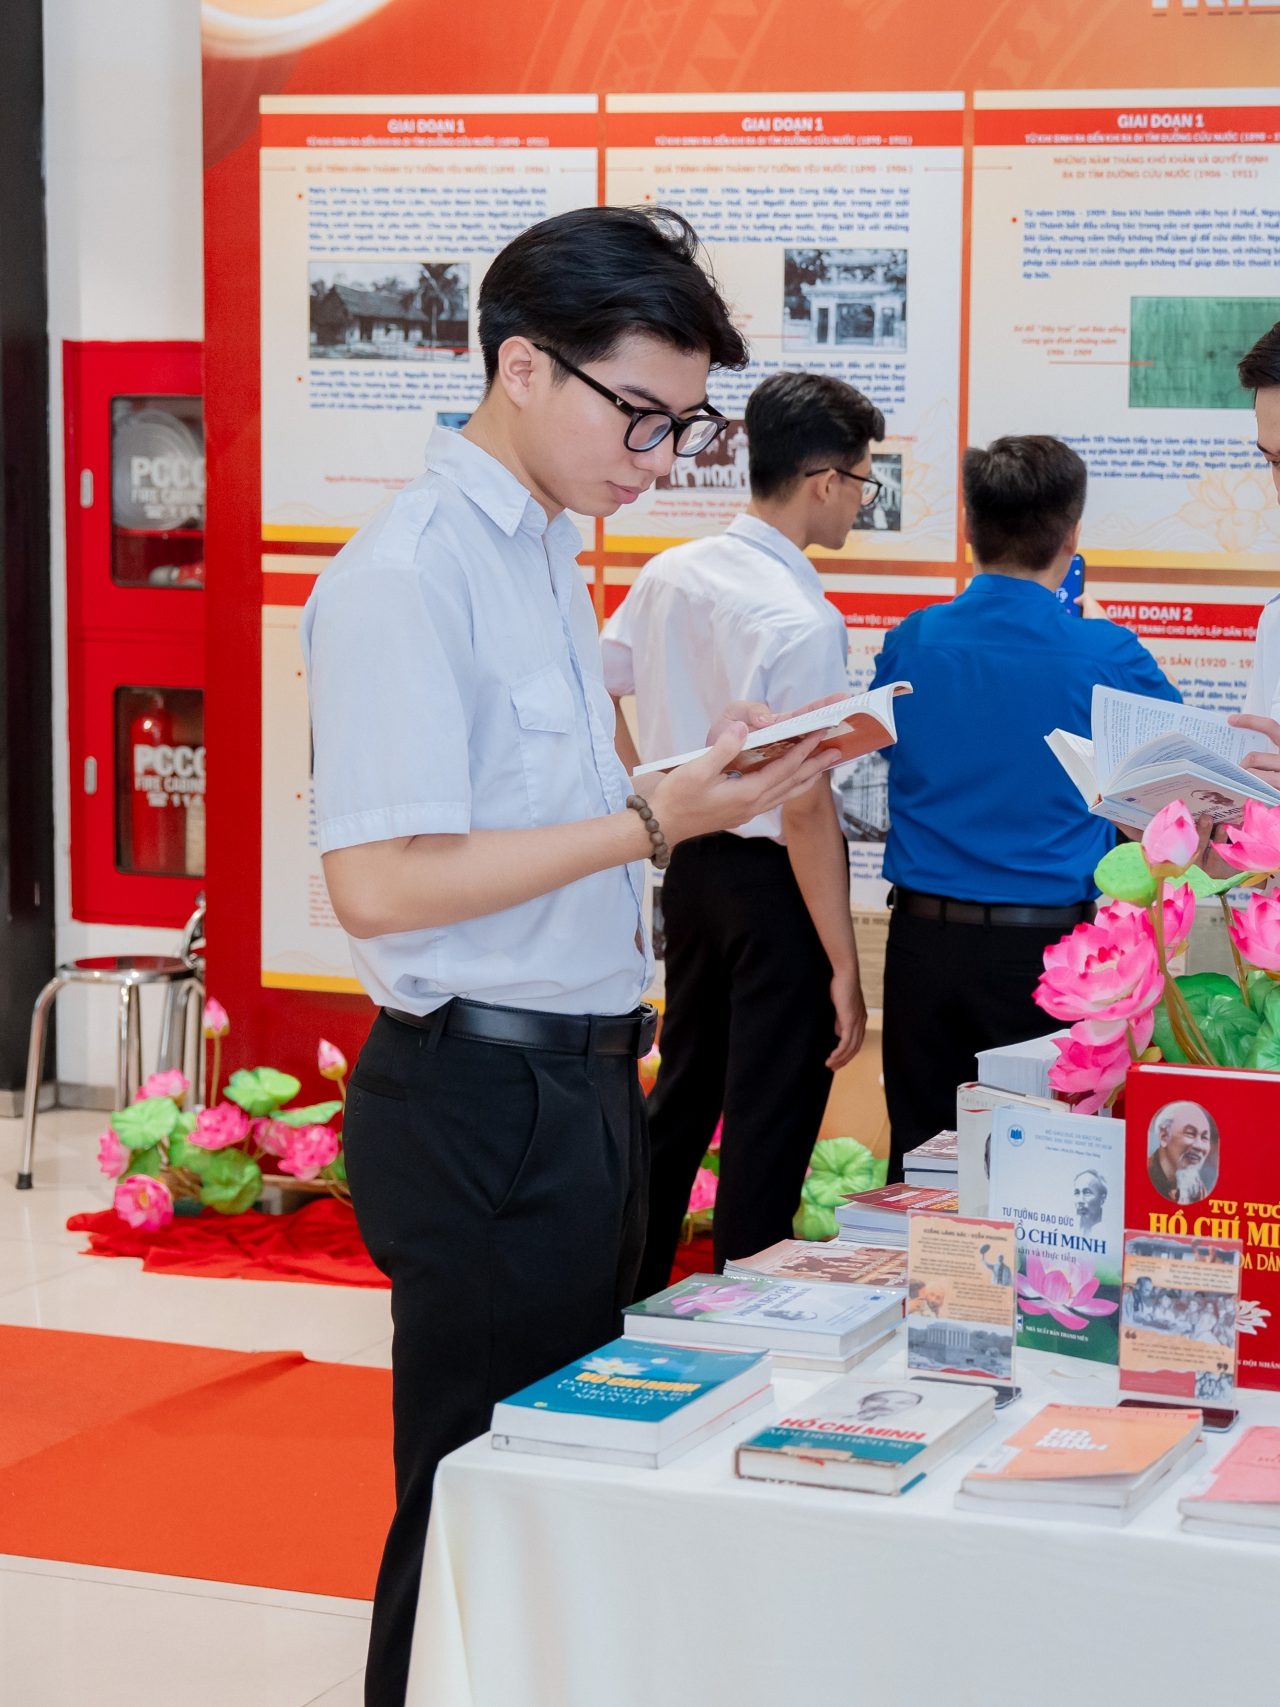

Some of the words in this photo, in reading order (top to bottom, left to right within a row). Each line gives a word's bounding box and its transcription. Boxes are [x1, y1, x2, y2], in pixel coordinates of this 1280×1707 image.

[387, 119, 416, 133] GIAI
[456, 119, 465, 133] 1
[742, 117, 771, 131] GIAI
[772, 117, 813, 134] ĐOẠN
[815, 117, 823, 131] 1
[1117, 114, 1148, 128] GIAI
[1150, 113, 1193, 131] ĐOẠN
[1196, 114, 1204, 127] 1
[1107, 605, 1136, 619] GIAI
[1138, 606, 1181, 624] ĐOẠN
[1183, 608, 1192, 621] 2
[1149, 1209, 1187, 1235] HỒ
[1193, 1216, 1240, 1240] CHÍ
[1015, 1219, 1026, 1241] Ồ
[1028, 1226, 1058, 1246] CHÍ
[1061, 1232, 1107, 1255] MINH
[779, 1417, 820, 1429] HỒ
[818, 1422, 863, 1434] CHÍ
[862, 1426, 927, 1441] MINH
